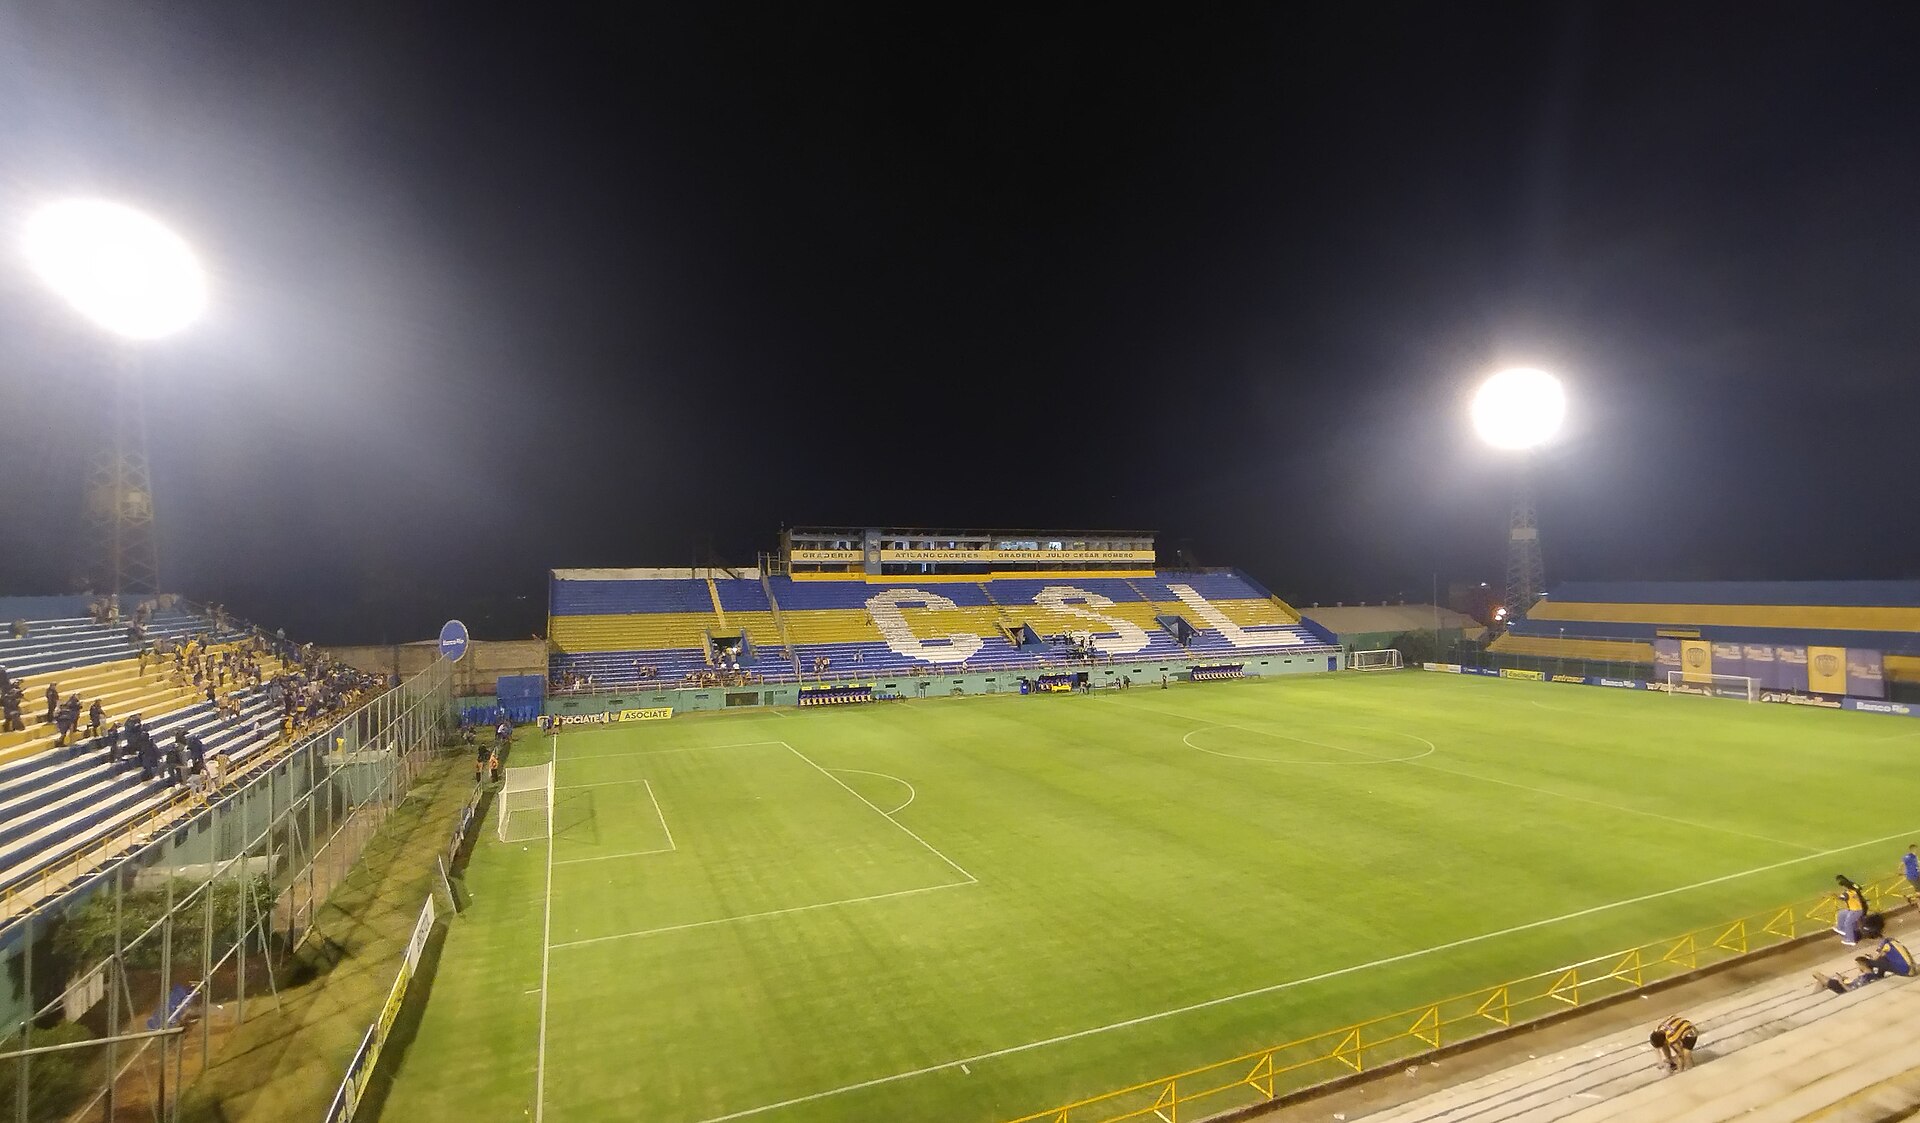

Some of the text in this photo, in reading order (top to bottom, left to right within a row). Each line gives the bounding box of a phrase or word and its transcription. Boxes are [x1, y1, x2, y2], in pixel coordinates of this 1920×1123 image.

[1856, 701, 1911, 714] Banco Rio
[560, 713, 600, 725] SOCIATE
[624, 710, 668, 720] ASOCIATE
